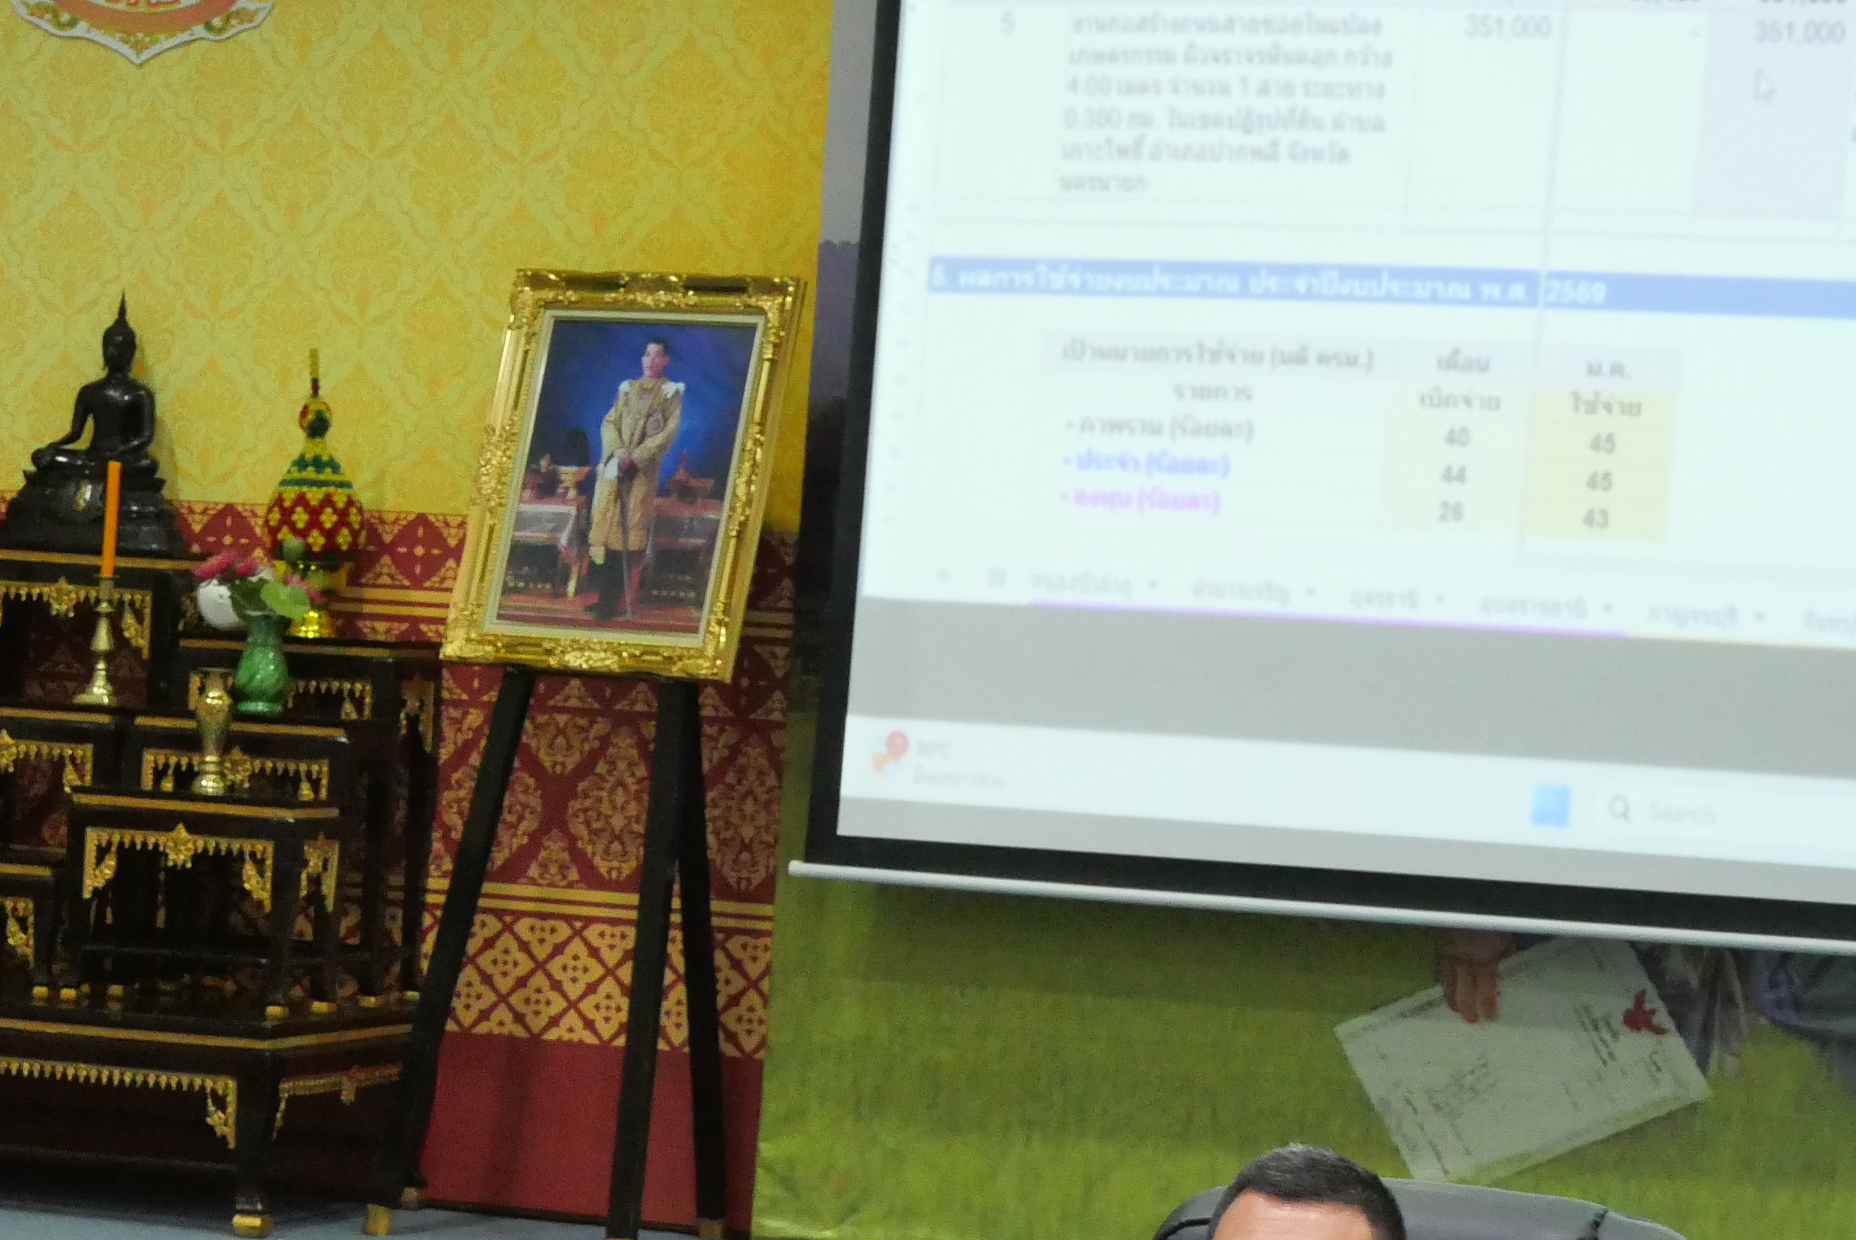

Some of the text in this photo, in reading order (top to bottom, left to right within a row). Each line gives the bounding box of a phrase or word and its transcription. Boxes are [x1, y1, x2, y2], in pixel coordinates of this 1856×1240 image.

[1464, 14, 1552, 42] 351,000
[1754, 19, 1846, 47] 351,000
[1444, 426, 1471, 448] 40
[1441, 464, 1467, 484] 44
